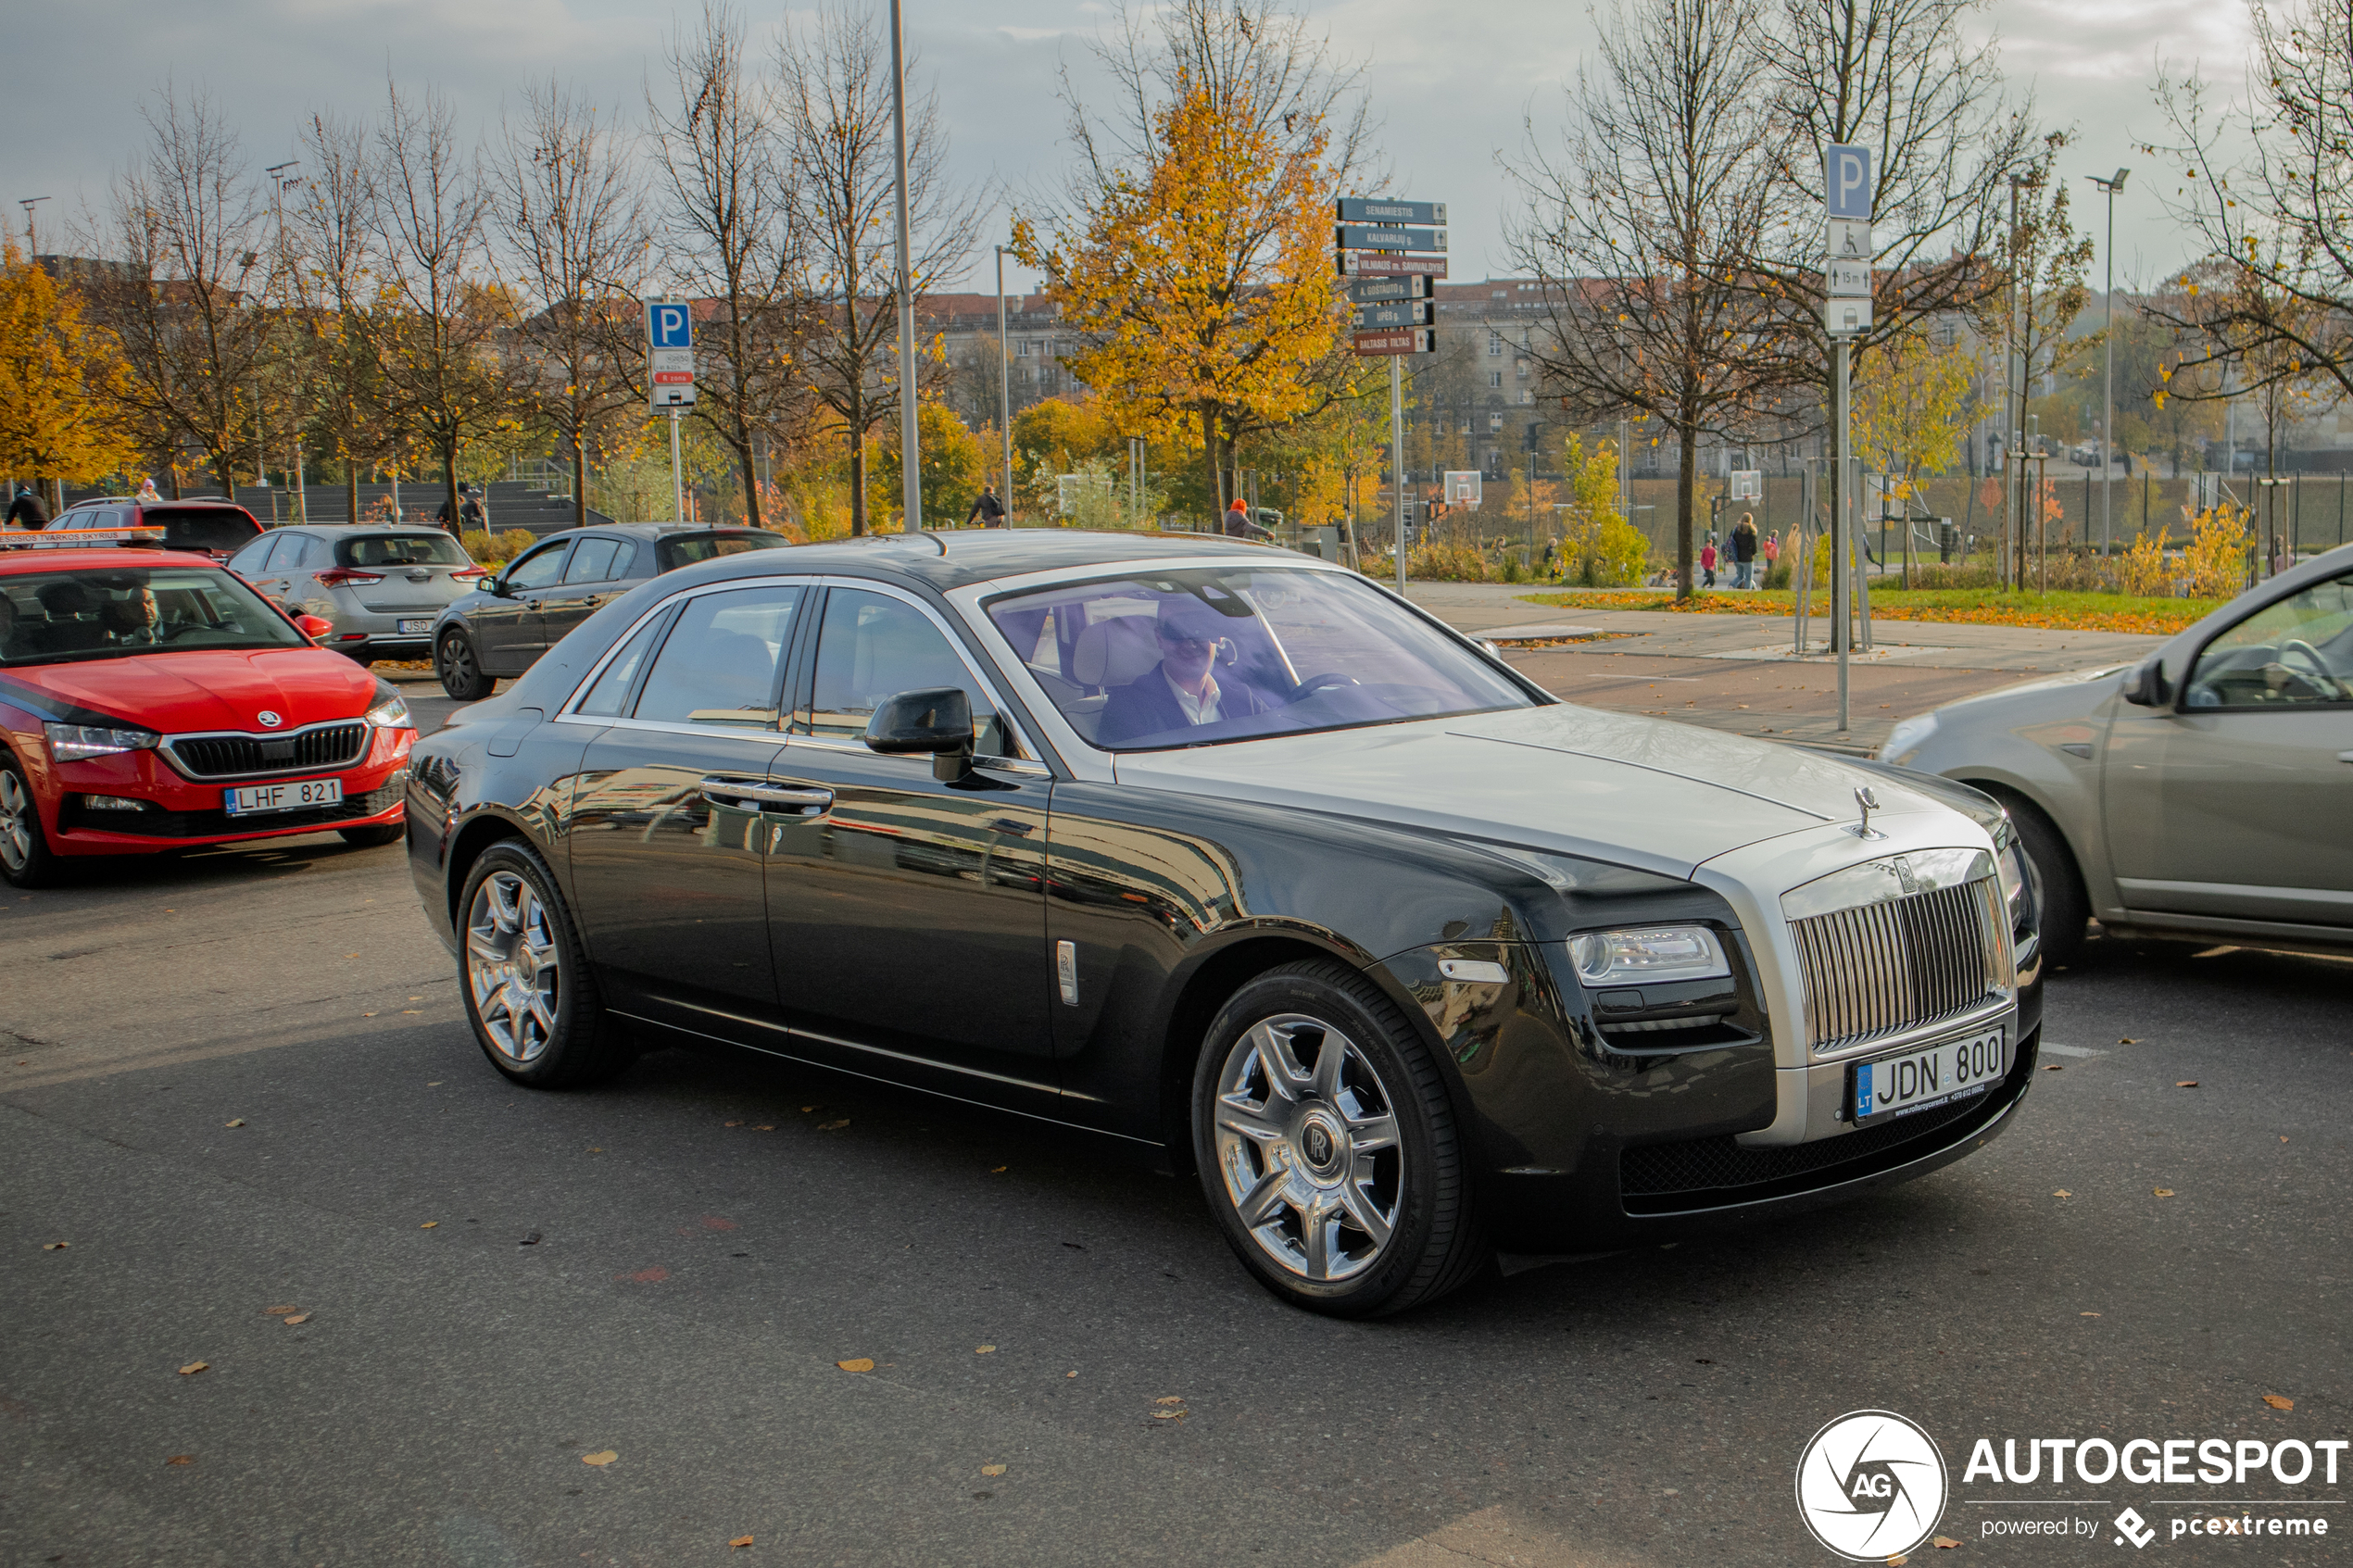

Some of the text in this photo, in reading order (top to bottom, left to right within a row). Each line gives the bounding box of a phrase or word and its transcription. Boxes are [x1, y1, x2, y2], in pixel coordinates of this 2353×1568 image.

[1839, 153, 1864, 209] P
[1365, 205, 1414, 217] SENAMIESTIS
[1366, 232, 1415, 245] KALVARIJŲ g.
[1360, 259, 1446, 272] VILNIAUS m. SAVIVALDYBĖ
[1843, 271, 1859, 284] 15 m
[1360, 286, 1366, 296] A.
[1398, 284, 1405, 294] g.
[1377, 310, 1400, 321] UPĖS g.
[660, 308, 683, 344] P
[1359, 336, 1410, 349] BALTASIS TILTAS
[40, 533, 81, 542] TVARKOS
[82, 532, 120, 541] SKYRIUS
[406, 621, 428, 632] JSD
[238, 786, 285, 809] LHF
[301, 782, 336, 803] 821
[1289, 988, 1317, 999] OUTSIDE
[1857, 1035, 1999, 1110] LT JDN 800
[1950, 1090, 1963, 1100] +370
[1962, 1087, 1972, 1098] 612
